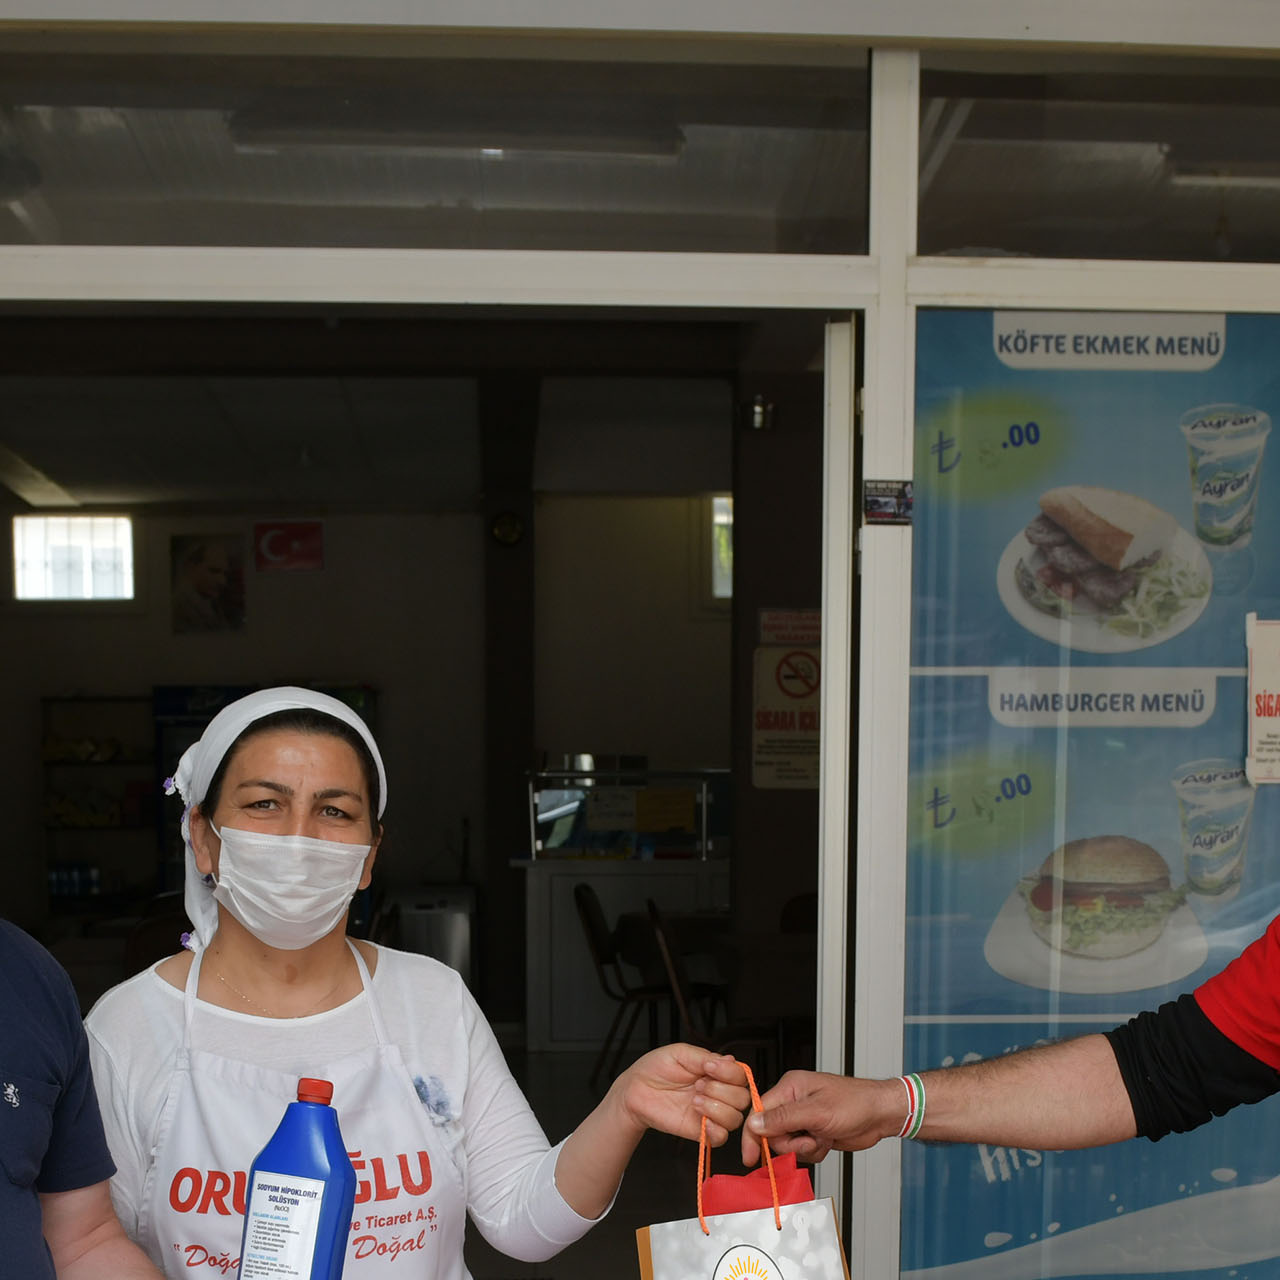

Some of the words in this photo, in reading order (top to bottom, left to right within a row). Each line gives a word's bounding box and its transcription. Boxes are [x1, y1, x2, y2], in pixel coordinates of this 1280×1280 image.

[998, 330, 1067, 354] KÖFTE
[1072, 334, 1150, 355] EKMEK
[1155, 332, 1220, 356] MENÜ
[1201, 471, 1250, 498] Ayran
[999, 693, 1136, 713] HAMBURGER
[1140, 689, 1205, 713] MENÜ
[1192, 823, 1240, 851] Ayran
[257, 1183, 280, 1194] SODYUM
[365, 1211, 412, 1229] Ticaret
[415, 1206, 438, 1222] A.Ş.
